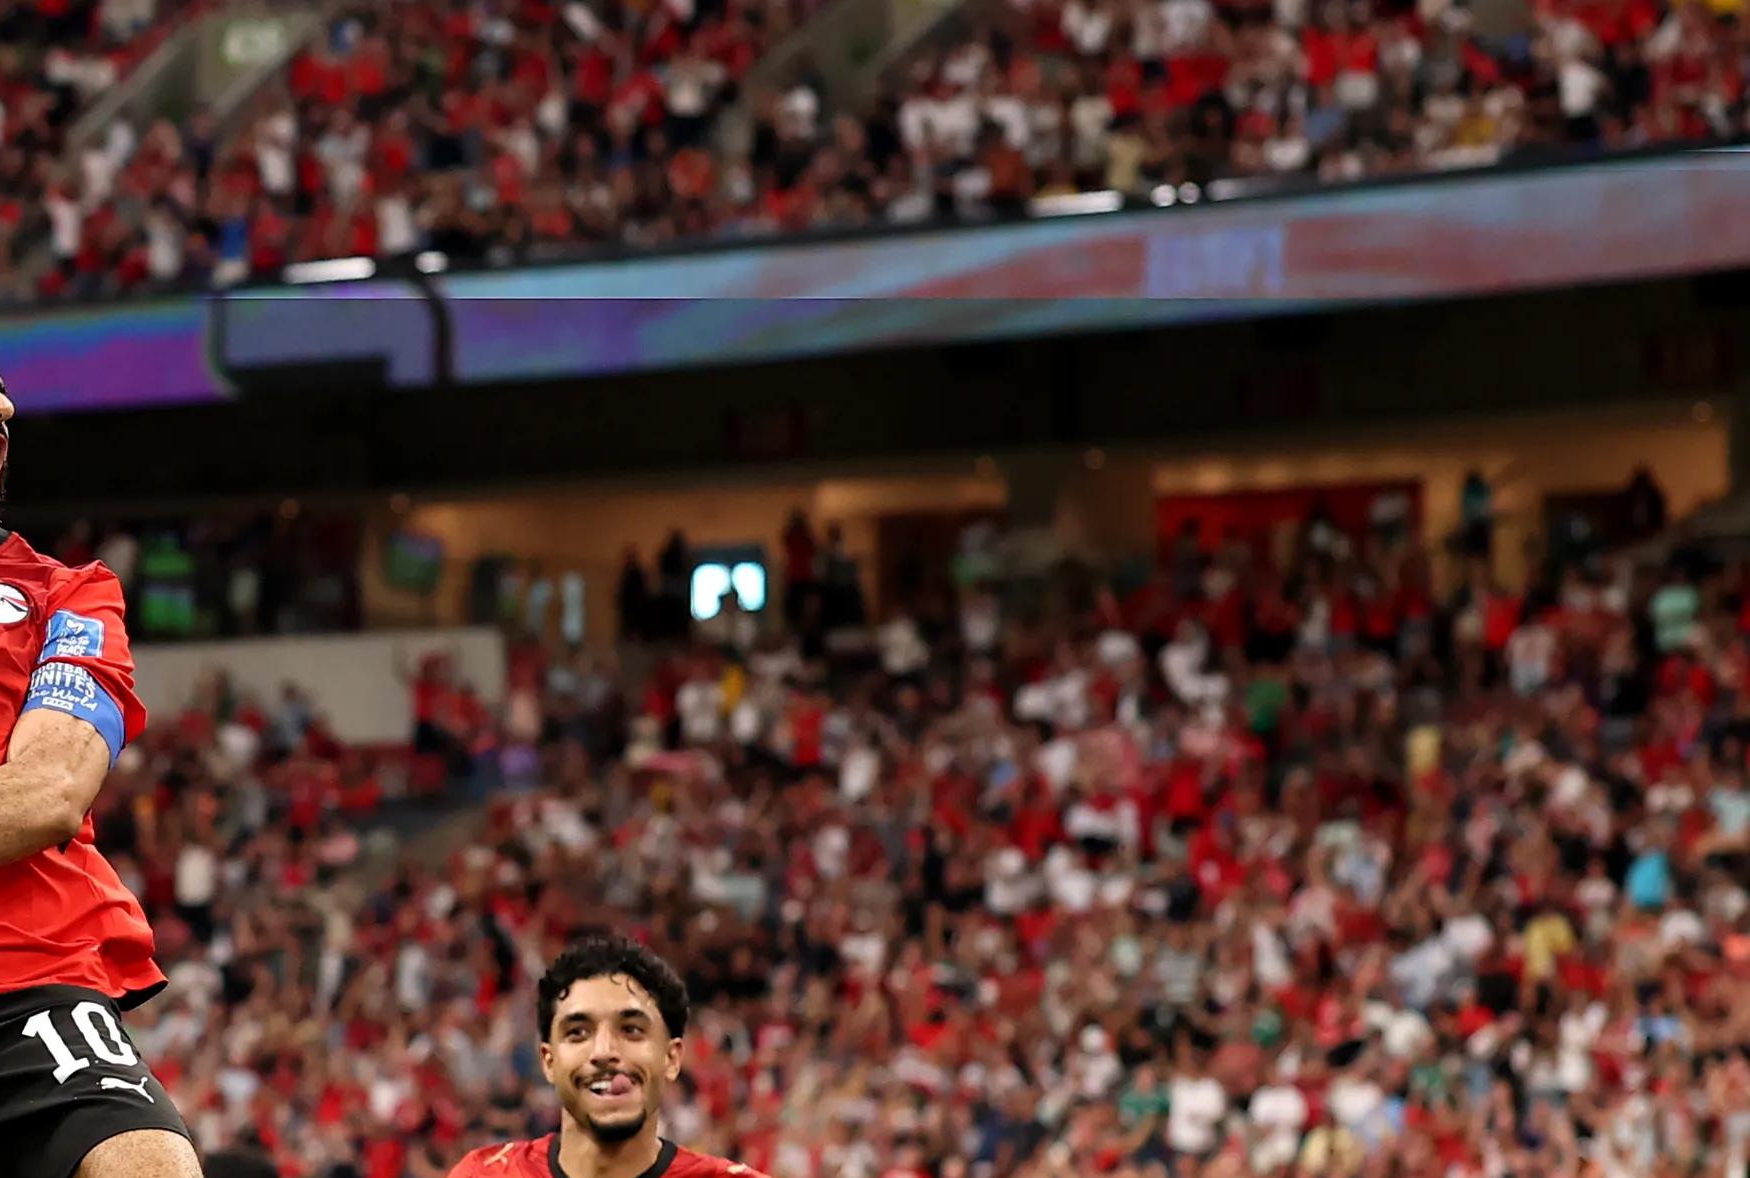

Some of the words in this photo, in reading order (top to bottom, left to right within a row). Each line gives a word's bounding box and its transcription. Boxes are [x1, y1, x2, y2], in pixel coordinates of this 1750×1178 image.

[56, 643, 87, 657] PEACE
[30, 669, 97, 699] UNITES
[36, 661, 94, 681] OTBAL
[51, 686, 99, 712] World
[21, 1001, 138, 1085] 10
